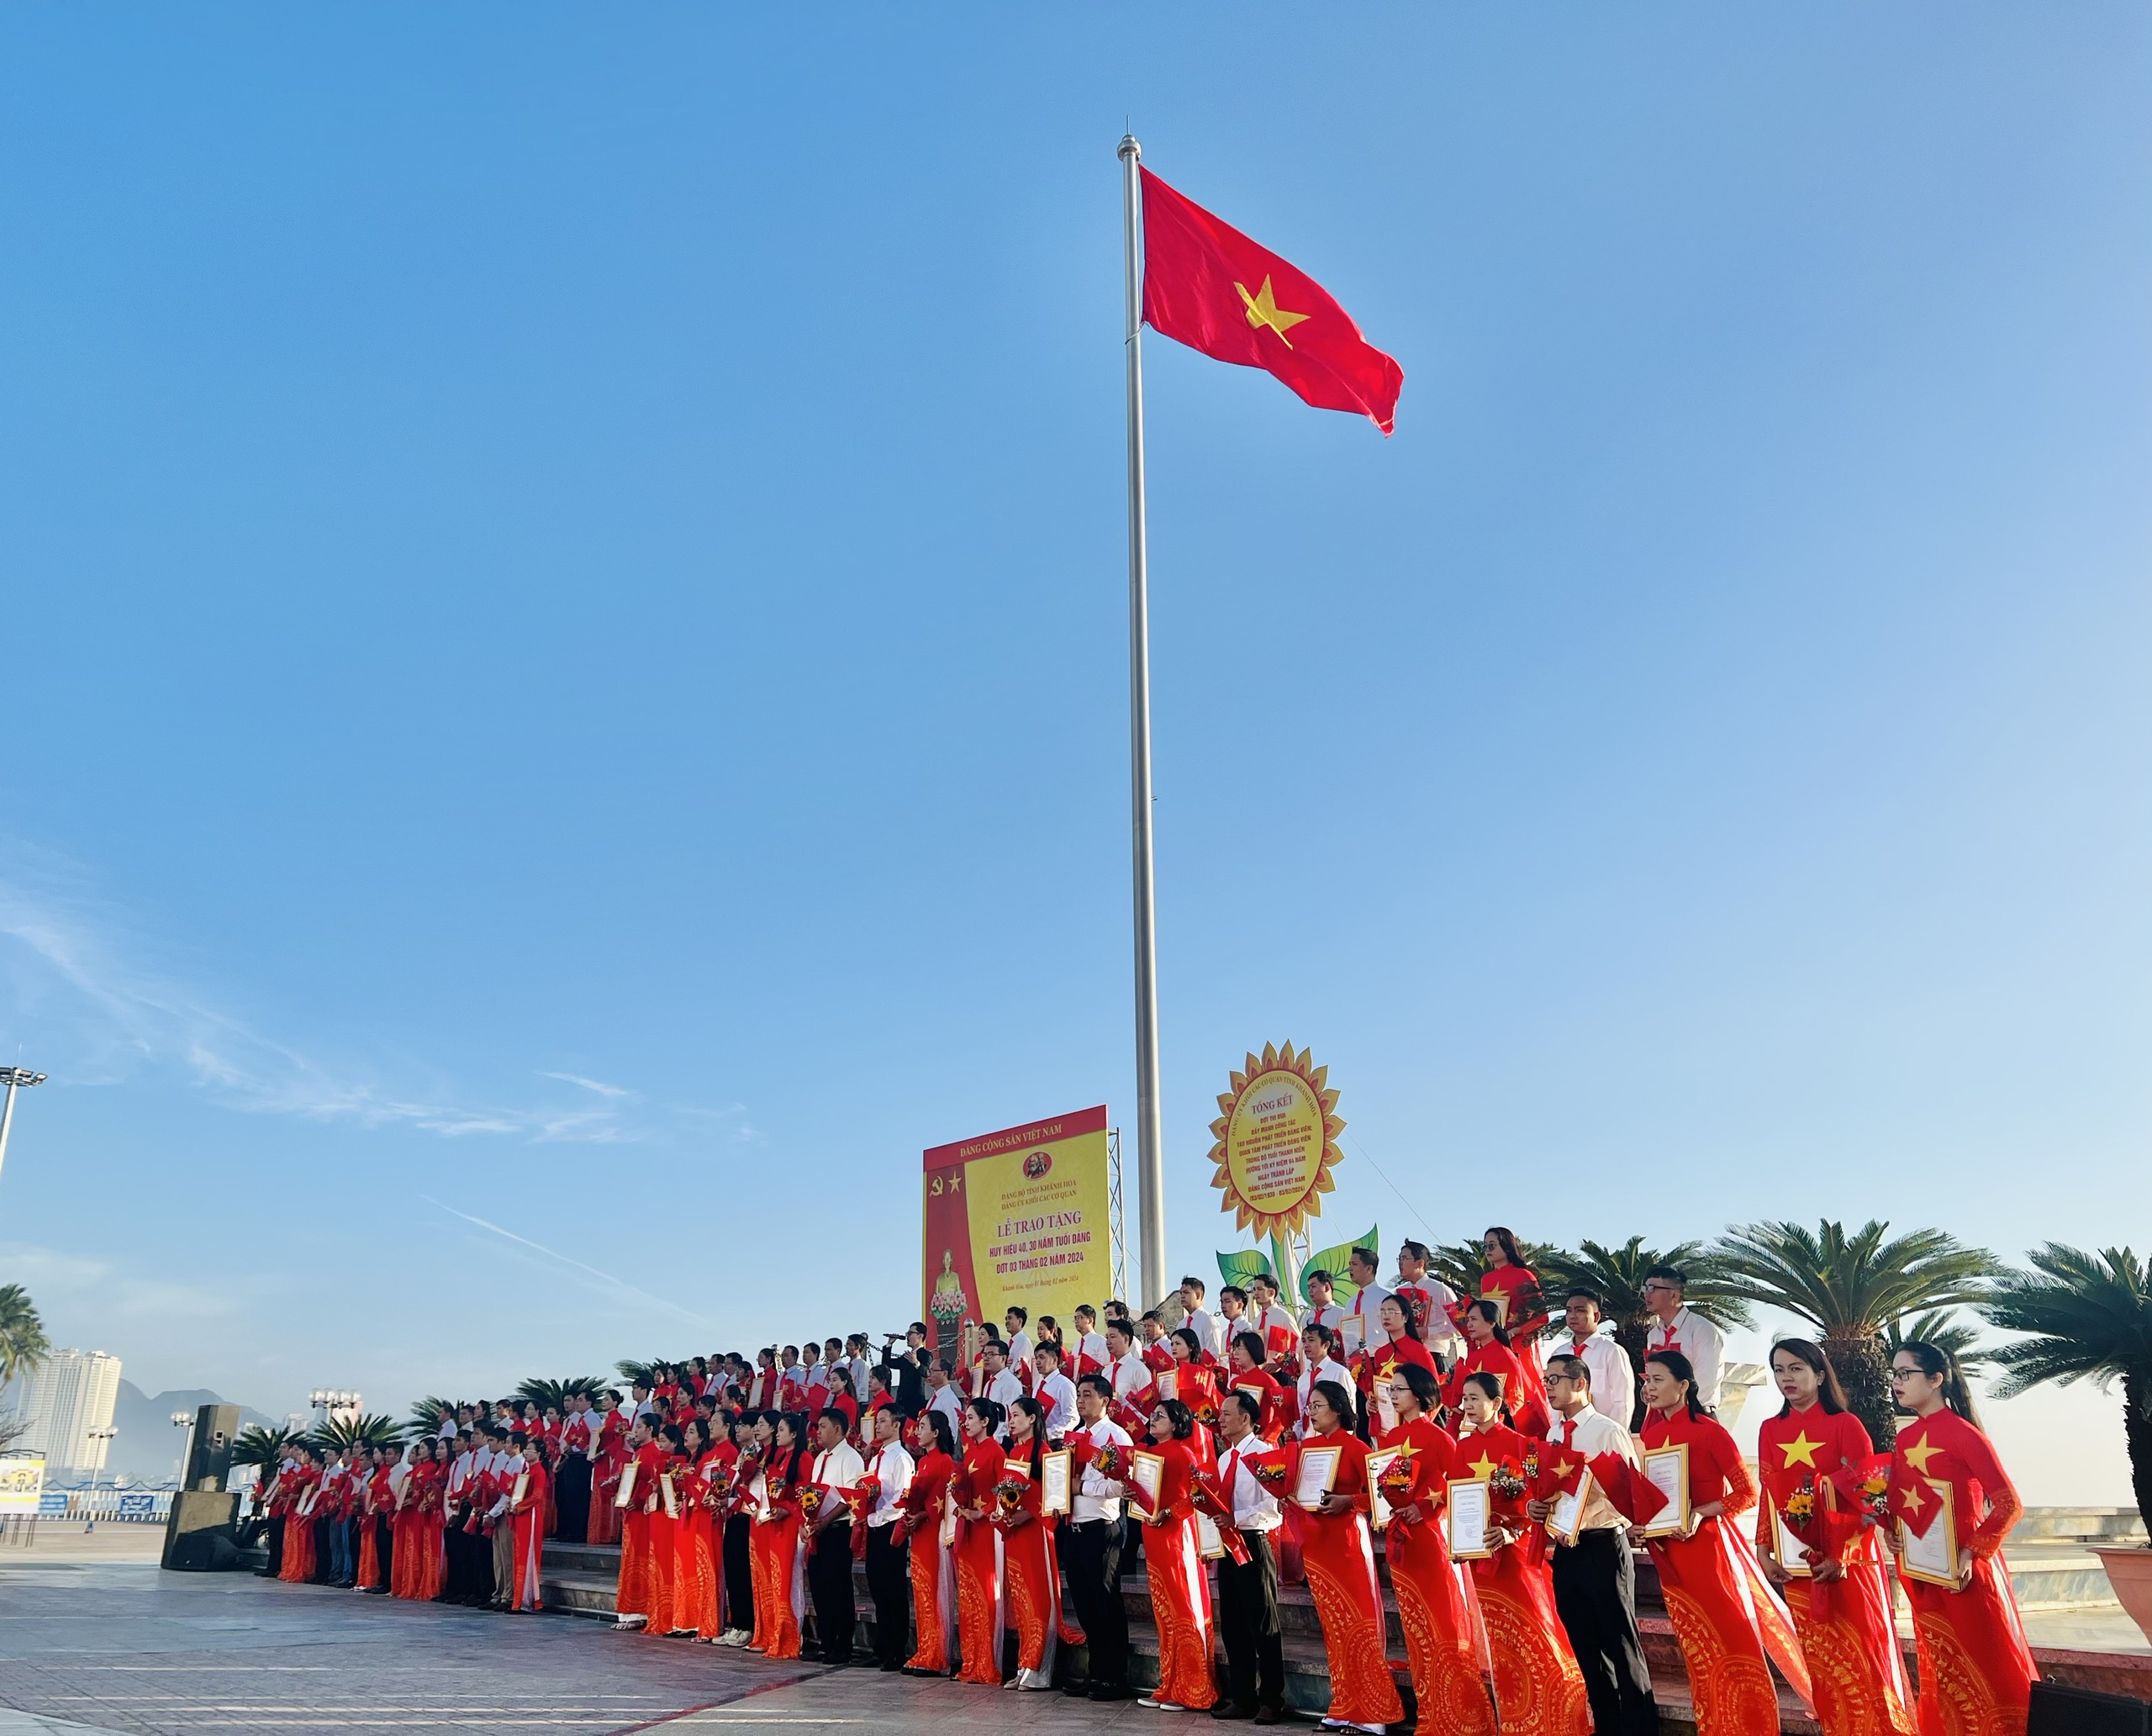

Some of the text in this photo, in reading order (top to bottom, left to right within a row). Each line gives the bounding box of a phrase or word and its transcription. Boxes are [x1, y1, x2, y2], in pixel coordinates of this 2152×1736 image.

[1252, 1092, 1293, 1115] TỔNG KẾT
[961, 1124, 1062, 1157] ĐẢNG CỘNG SẢN VIỆT NAM
[1041, 1181, 1062, 1192] KHÁNH
[1060, 1190, 1076, 1199] QUAN
[998, 1211, 1081, 1237] LỄ TRAO TẶNG
[990, 1230, 1090, 1258] HUY HIỆU 40, 30 NĂM TUỔI ĐẢNG
[997, 1262, 1007, 1274] ĐỢT
[1010, 1262, 1016, 1272] 03
[1040, 1257, 1047, 1267] 02
[1050, 1253, 1065, 1265] NĂM
[1068, 1252, 1084, 1263] 2024
